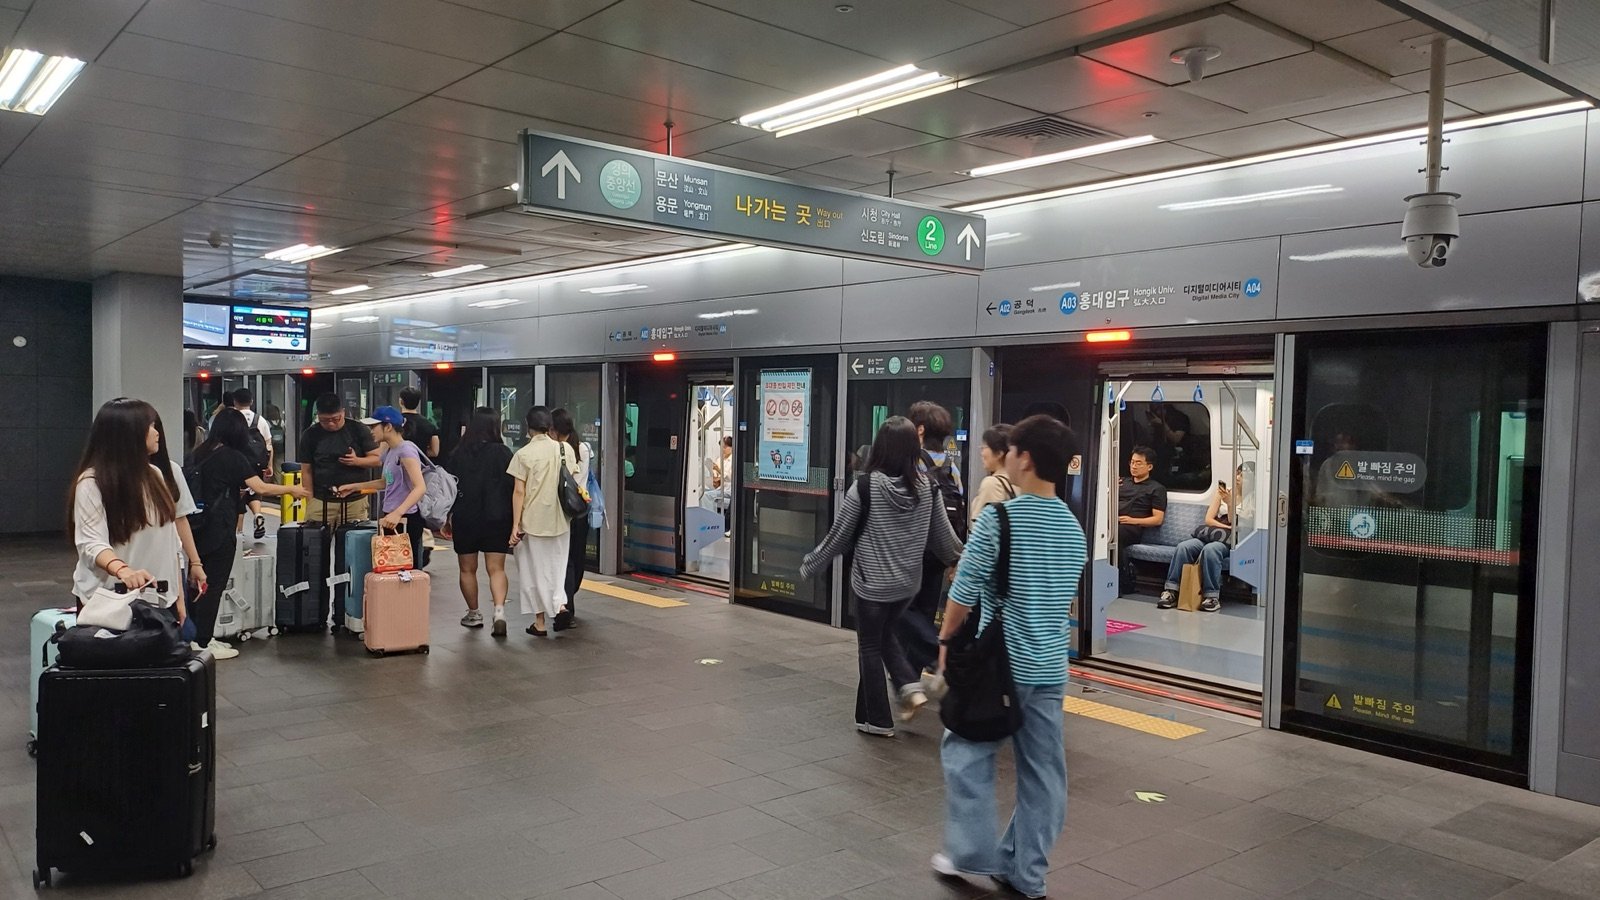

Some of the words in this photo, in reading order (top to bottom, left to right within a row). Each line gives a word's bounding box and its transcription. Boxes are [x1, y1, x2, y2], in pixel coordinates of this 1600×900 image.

[607, 175, 635, 193] 중앙선
[656, 171, 678, 189] 문산
[684, 174, 708, 186] Munsan
[656, 196, 678, 214] 용문
[684, 200, 712, 211] Yongmun
[736, 195, 786, 222] 나가는
[796, 204, 812, 225] 곳
[816, 208, 831, 218] Way
[862, 208, 878, 222] 시청
[881, 210, 890, 218] City
[816, 219, 831, 228] 出口
[861, 229, 885, 244] 신도림
[888, 232, 909, 241] Sindorim
[926, 220, 936, 241] 2
[925, 242, 937, 250] Line
[1134, 287, 1157, 297] Hongik
[1158, 286, 1176, 294] Univ.
[1183, 281, 1241, 295] 디지털미디어시티
[1246, 283, 1260, 293] A04
[1061, 297, 1077, 310] A03
[1080, 290, 1129, 311] 홍대입구
[1133, 297, 1166, 307] 弘大入口
[1000, 304, 1011, 314] A02
[650, 326, 673, 340] 홍대입구
[934, 356, 940, 367] 2
[1358, 461, 1368, 472] 발
[1370, 462, 1391, 474] 빠짐
[1394, 462, 1416, 475] 주의
[1392, 702, 1415, 716] 주의
